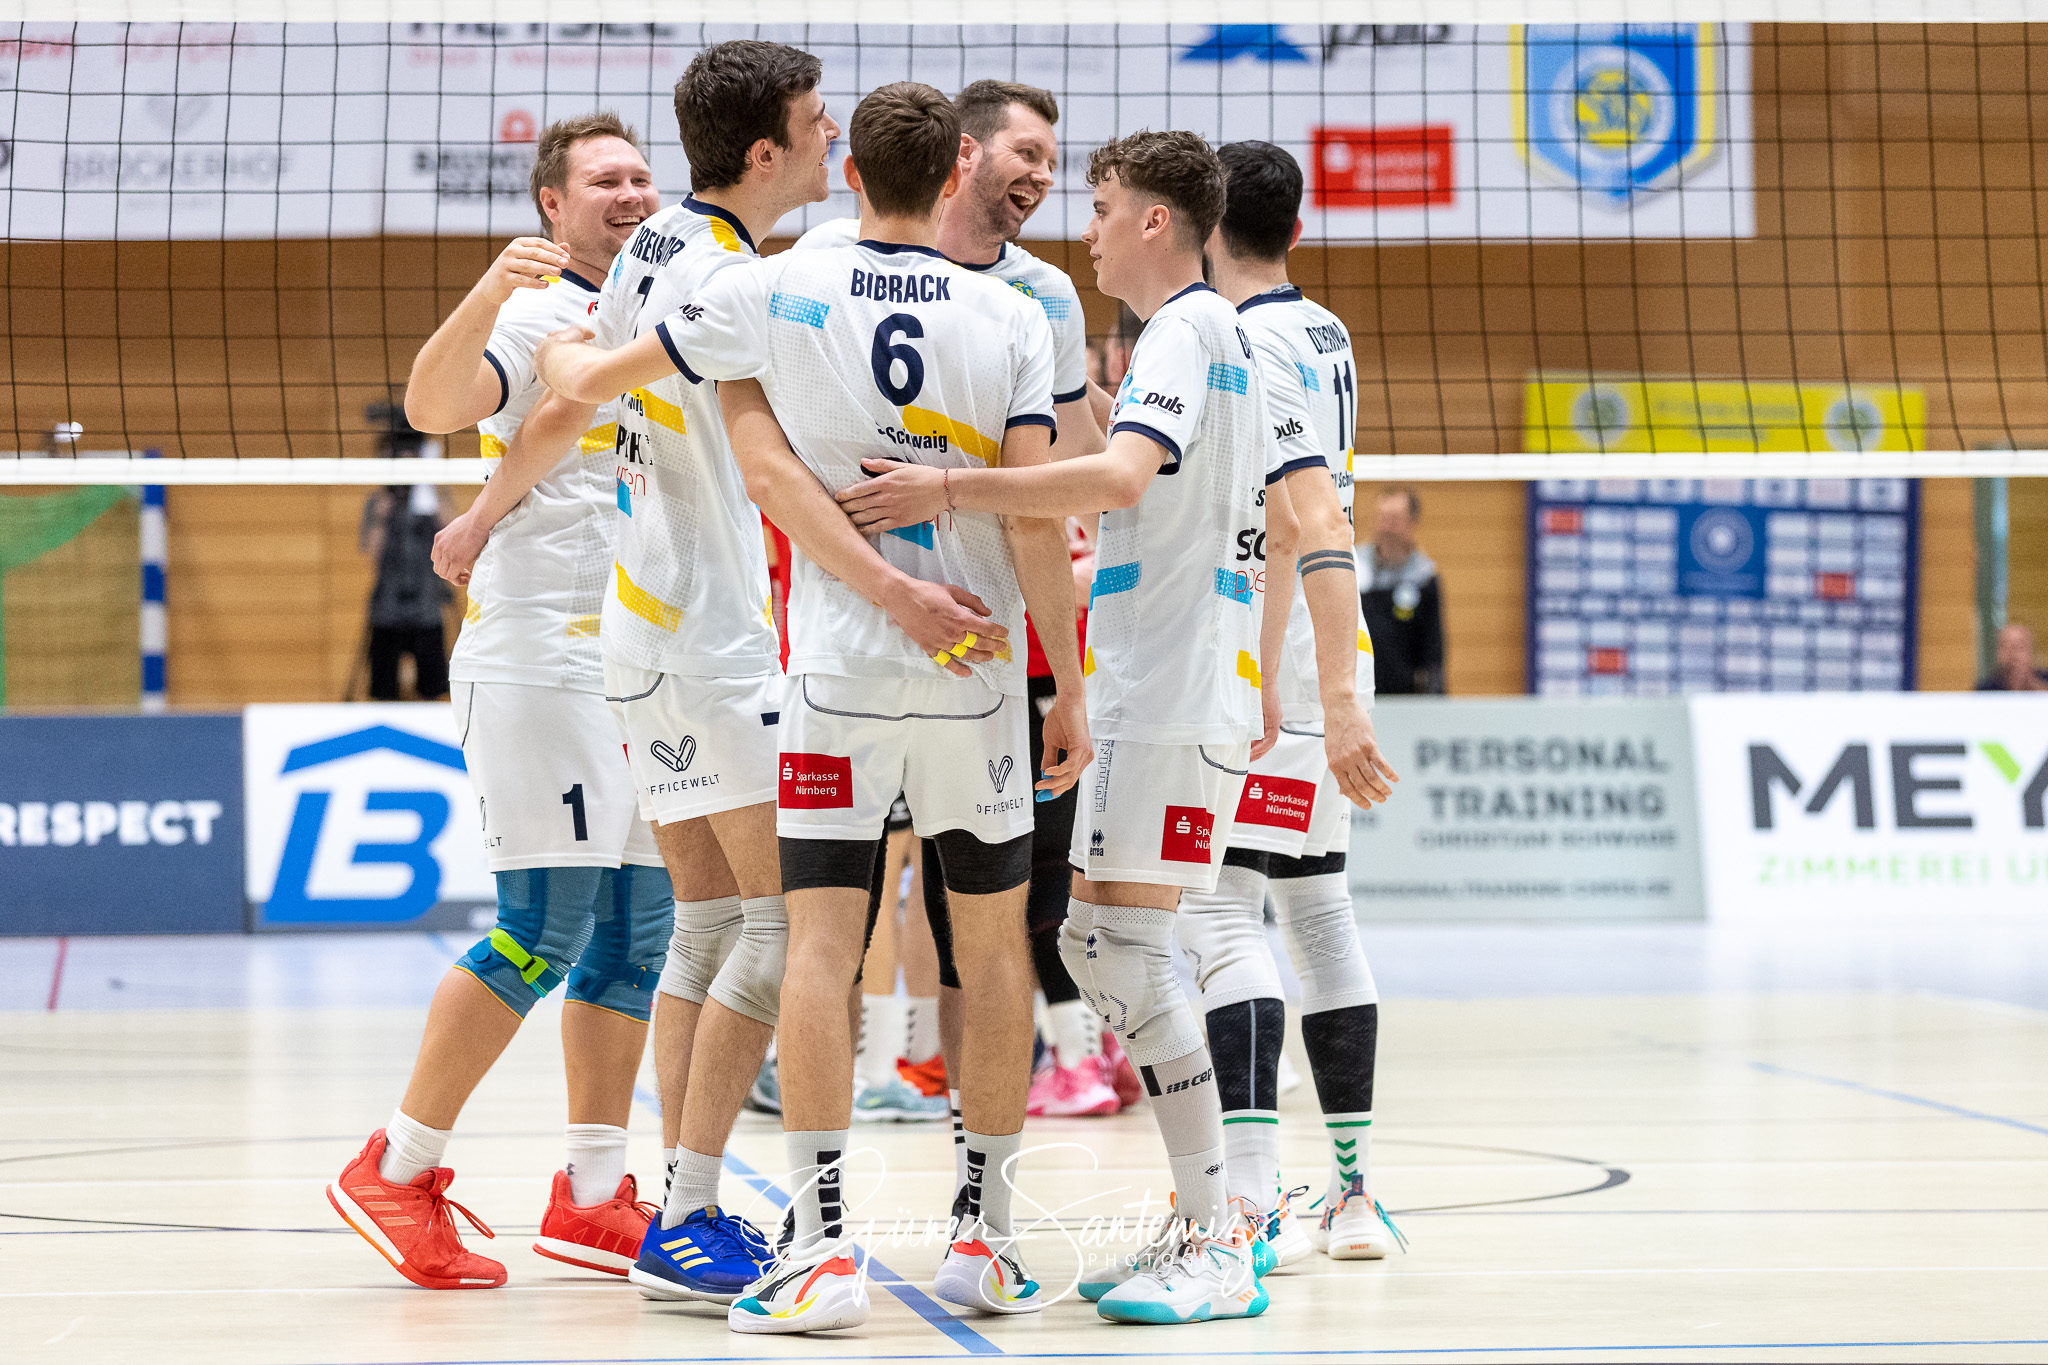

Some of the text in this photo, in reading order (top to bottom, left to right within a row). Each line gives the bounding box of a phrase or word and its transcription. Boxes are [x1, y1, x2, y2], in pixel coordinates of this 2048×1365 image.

[850, 268, 951, 304] BIBRACK
[871, 312, 926, 408] 6
[1142, 391, 1186, 416] puls
[1333, 360, 1355, 452] 11
[885, 426, 948, 454] Scwaig
[1415, 738, 1670, 775] PERSONAL
[646, 773, 720, 796] FFICEWELT
[796, 771, 840, 783] Sparkasse
[1748, 742, 2048, 829] MEY
[562, 783, 589, 842] 1
[1265, 804, 1306, 821] Nürnberg
[1267, 791, 1309, 808] Sparkasse
[1426, 786, 1666, 822] TRAINING
[0, 800, 223, 847] RESPECT
[1758, 855, 1990, 885] ZIMMEREI
[1190, 1067, 1213, 1087] cep
